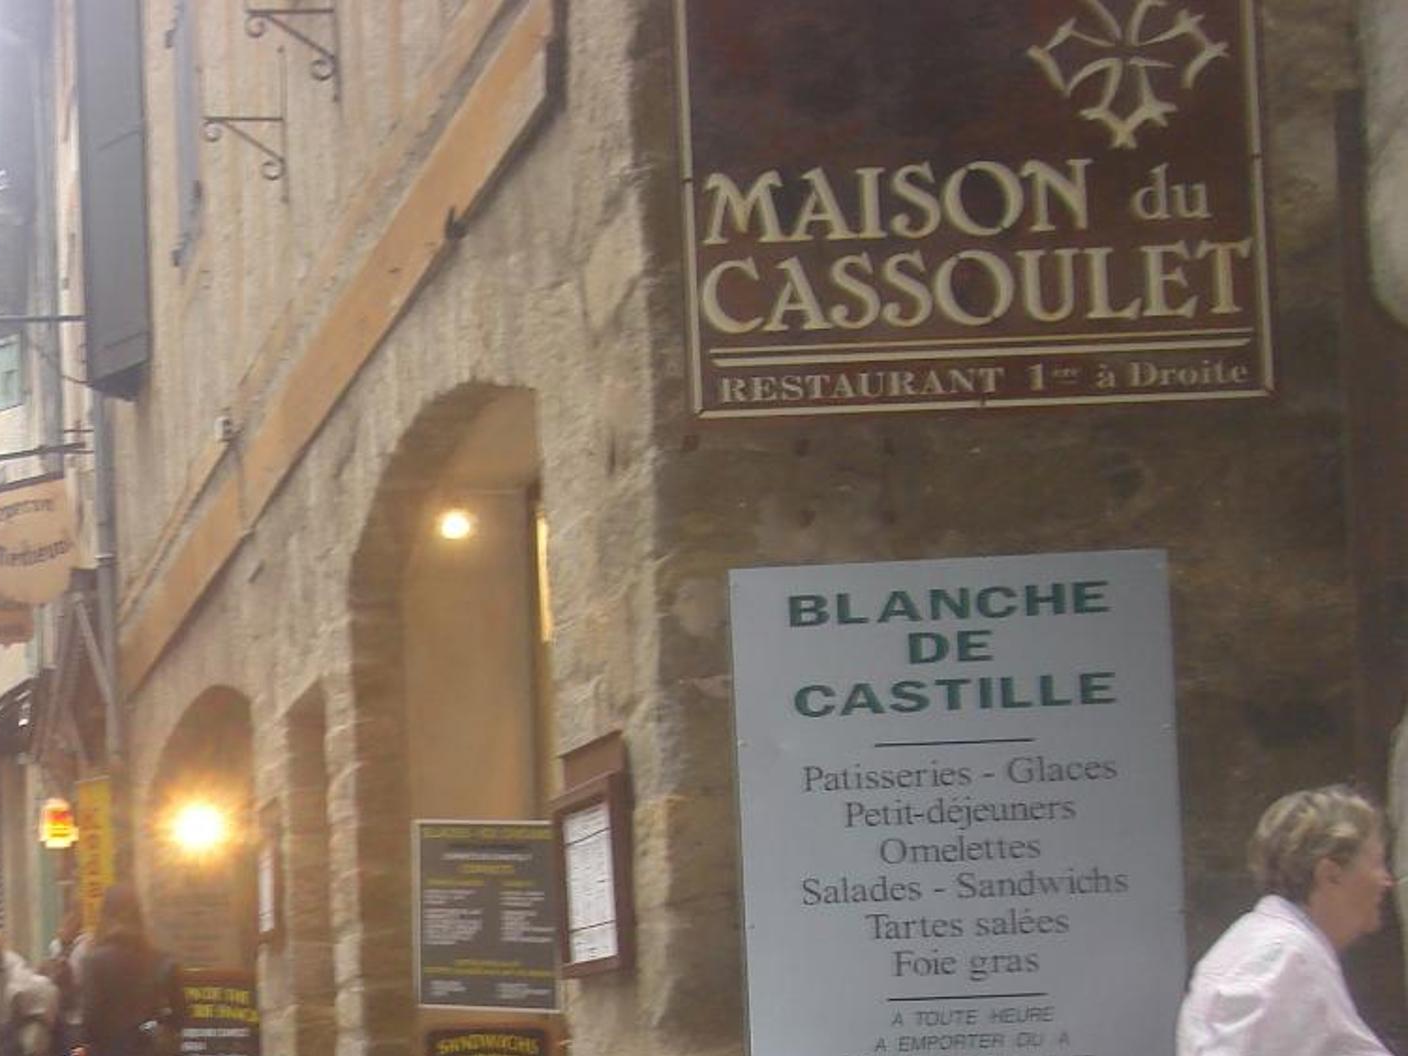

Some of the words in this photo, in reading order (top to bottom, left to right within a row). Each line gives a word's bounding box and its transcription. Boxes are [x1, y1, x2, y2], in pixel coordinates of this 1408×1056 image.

[701, 157, 1092, 244] MAISON
[1131, 162, 1212, 221] du
[701, 236, 1254, 335] CASSOULET
[721, 367, 1005, 404] RESTAURANT
[1094, 363, 1116, 390] à
[1128, 357, 1250, 388] Droite
[788, 580, 1111, 627] BLANCHE
[907, 629, 997, 665] DE
[794, 672, 1119, 719] CASTILLE
[802, 760, 973, 793] Patisseries
[1006, 755, 1119, 785] Glaces
[844, 797, 1077, 830] Petit-déjeuners
[879, 836, 1042, 865] Omelettes
[802, 876, 923, 906] Salades
[956, 867, 1130, 900] Sandwichs
[865, 912, 964, 940] Tartes
[975, 907, 1070, 936] salées
[894, 949, 957, 977] Foie
[968, 952, 1041, 982] gras
[891, 1010, 905, 1027] A
[915, 1007, 977, 1027] TOUTE
[991, 1005, 1055, 1024] HEURE
[874, 1036, 888, 1053] A
[898, 1032, 1005, 1053] EMPORTER
[1016, 1031, 1044, 1050] OU
[1057, 1030, 1072, 1047] A
